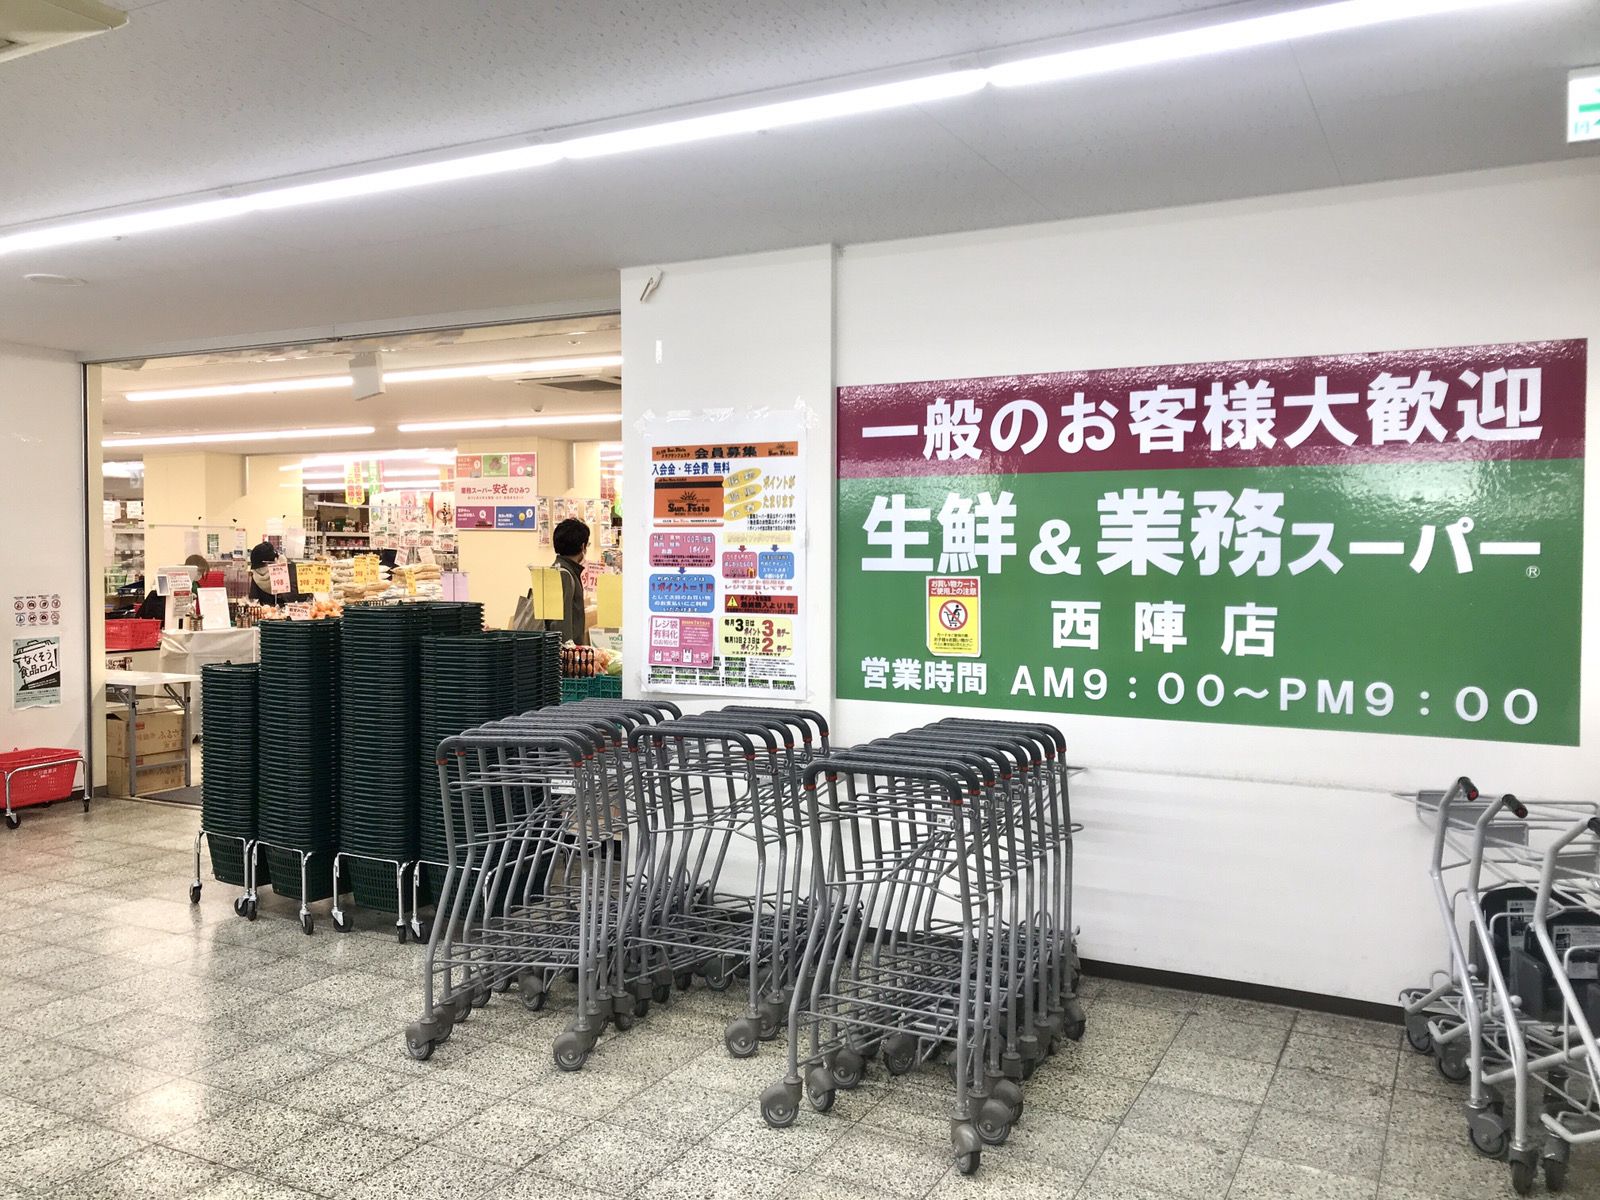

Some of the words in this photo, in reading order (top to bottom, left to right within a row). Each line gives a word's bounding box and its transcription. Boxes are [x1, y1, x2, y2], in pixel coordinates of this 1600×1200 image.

[862, 367, 1543, 461] 一般のお客様大歓迎
[652, 462, 709, 476] 入会金・年会費
[713, 461, 730, 474] 無料
[22, 649, 52, 665] なくそう
[861, 655, 987, 695] 営業時間
